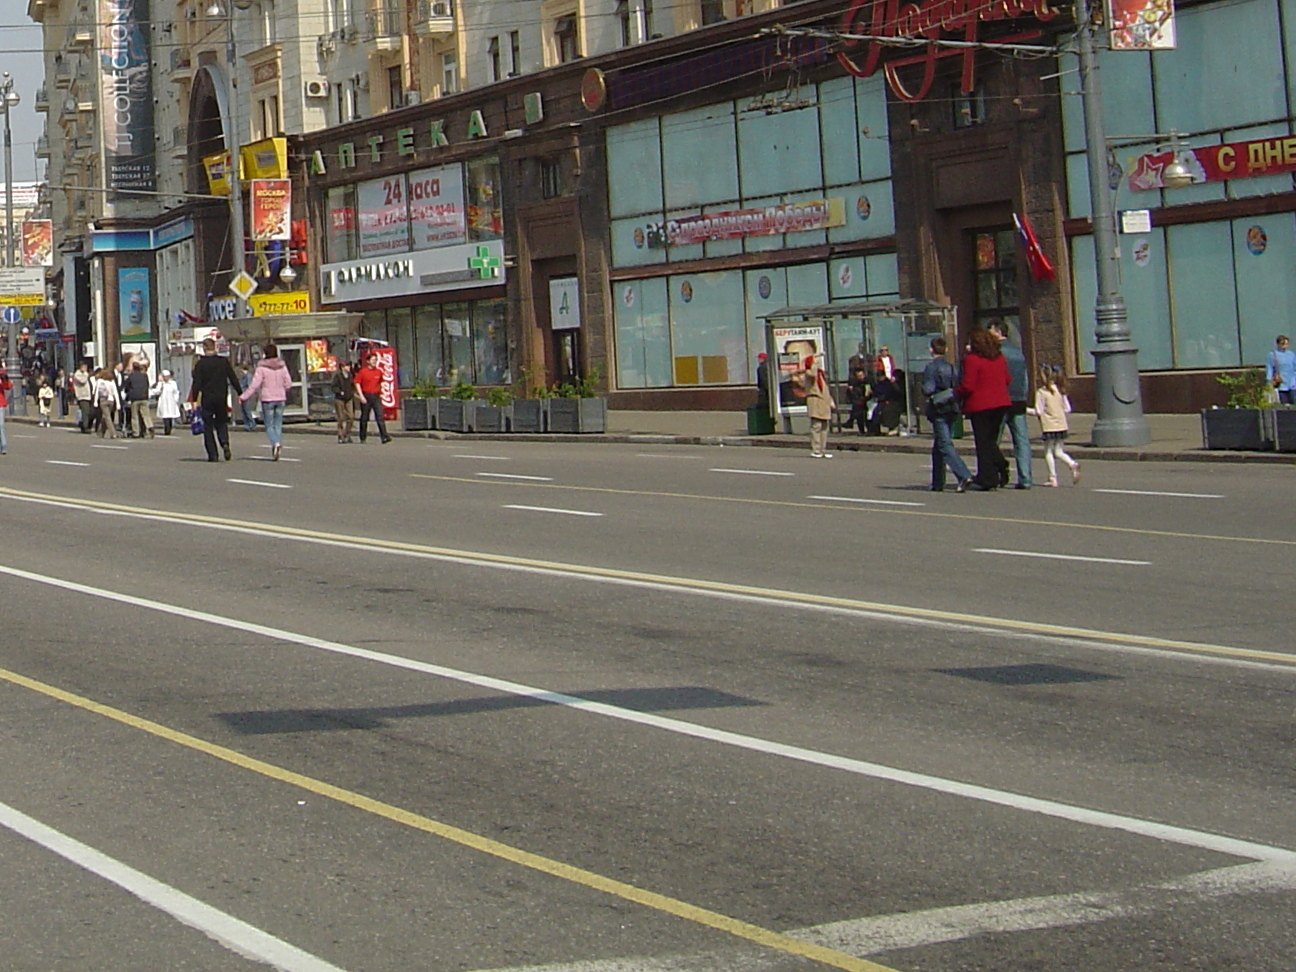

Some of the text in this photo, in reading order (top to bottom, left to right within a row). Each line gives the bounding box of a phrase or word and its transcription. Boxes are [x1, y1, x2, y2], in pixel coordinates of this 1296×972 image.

[110, 7, 133, 129] COLLECTION
[310, 109, 489, 175] АПТЕКА
[1217, 145, 1236, 173] С
[382, 178, 402, 206] 24
